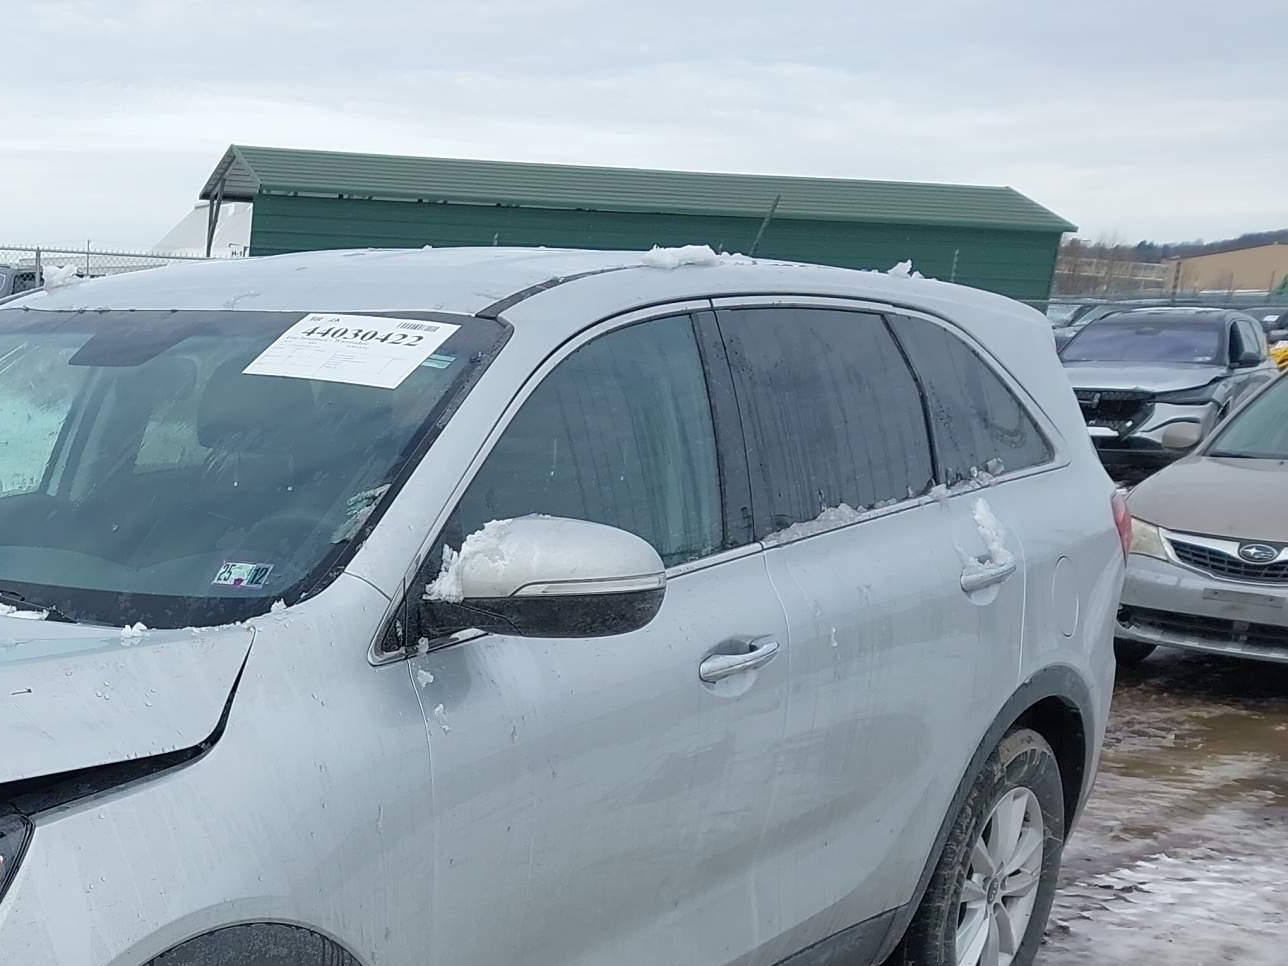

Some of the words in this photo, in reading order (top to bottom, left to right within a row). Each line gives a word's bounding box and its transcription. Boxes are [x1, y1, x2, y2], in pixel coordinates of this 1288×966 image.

[302, 326, 425, 347] 44030422
[217, 564, 236, 581] 25
[250, 567, 269, 585] 12
